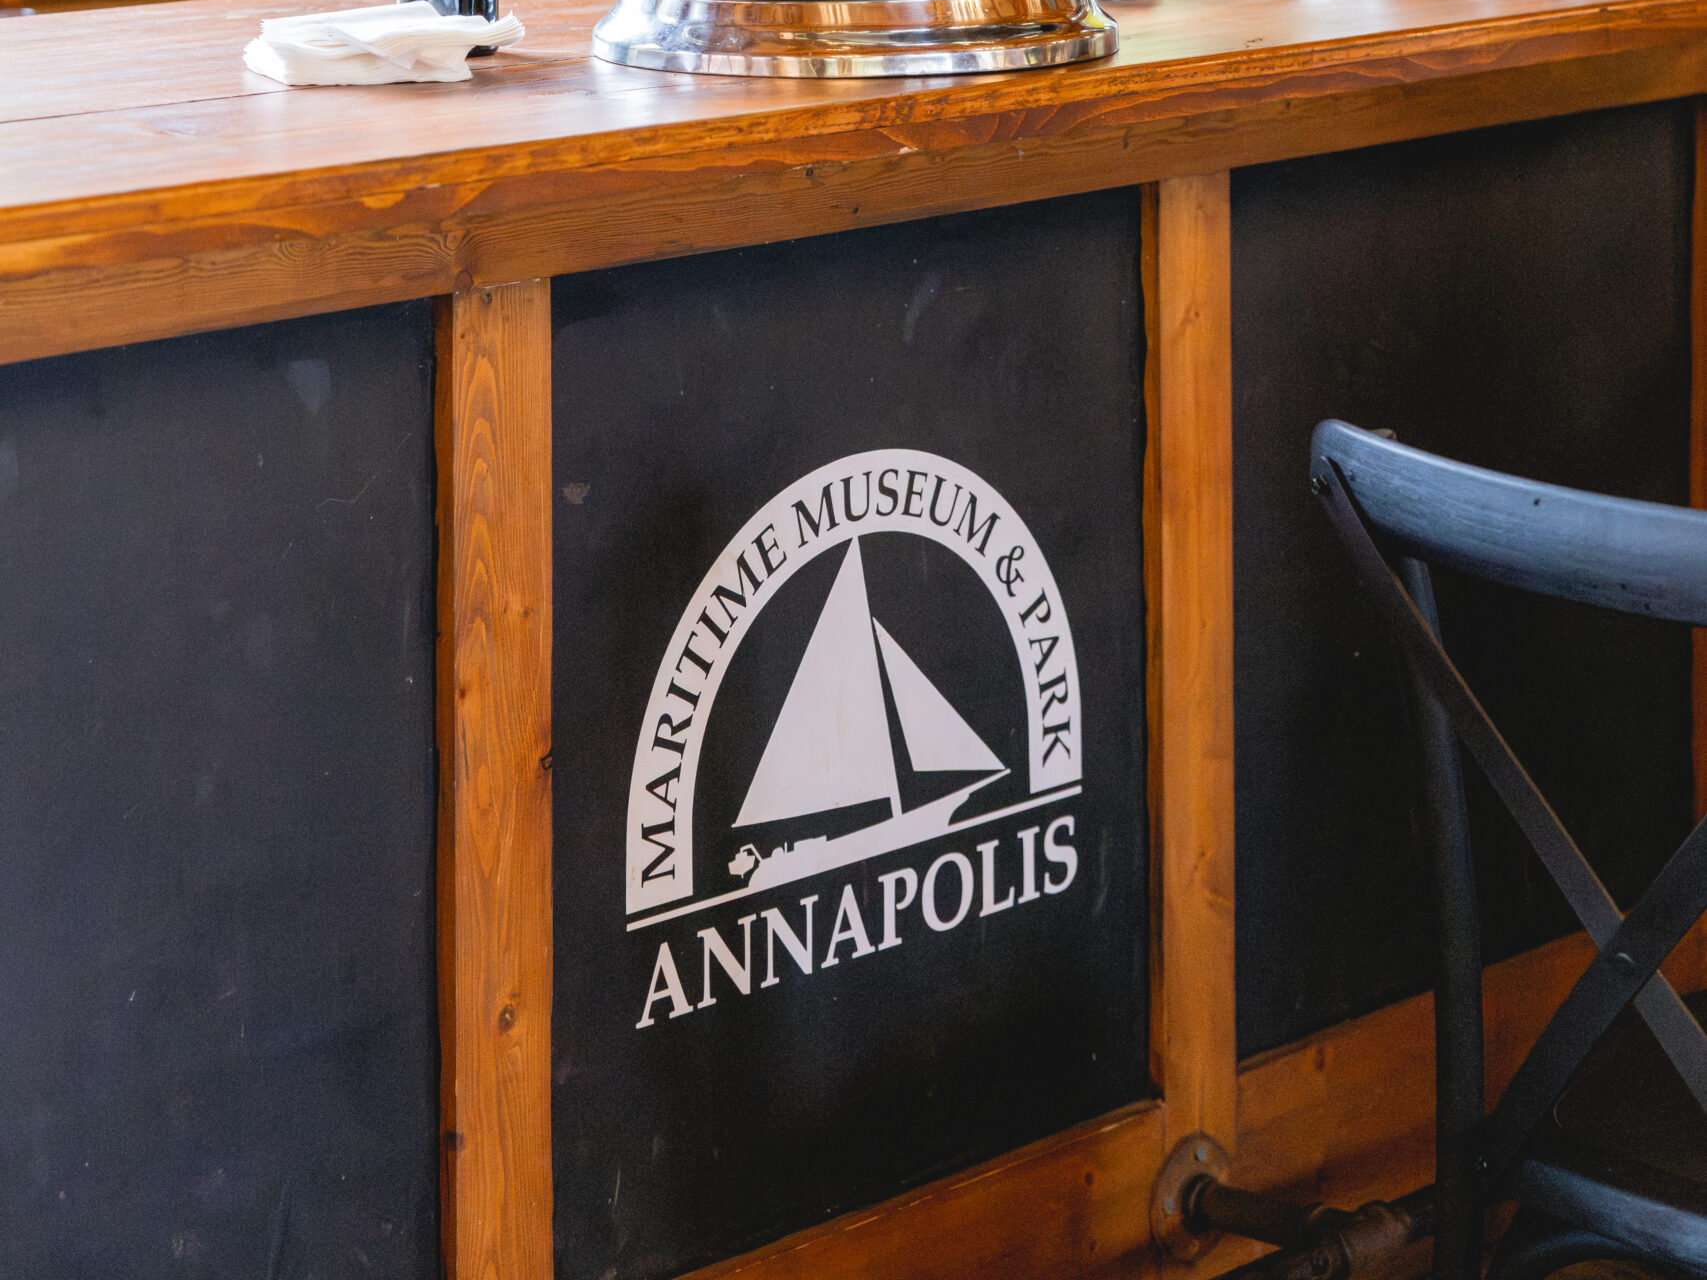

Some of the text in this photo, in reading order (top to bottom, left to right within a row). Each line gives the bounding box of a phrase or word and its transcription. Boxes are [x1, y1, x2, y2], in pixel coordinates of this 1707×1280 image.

[641, 468, 1072, 888] MARITIME MUSEUM & PARK
[636, 815, 1078, 1029] ANNAPOLIS
